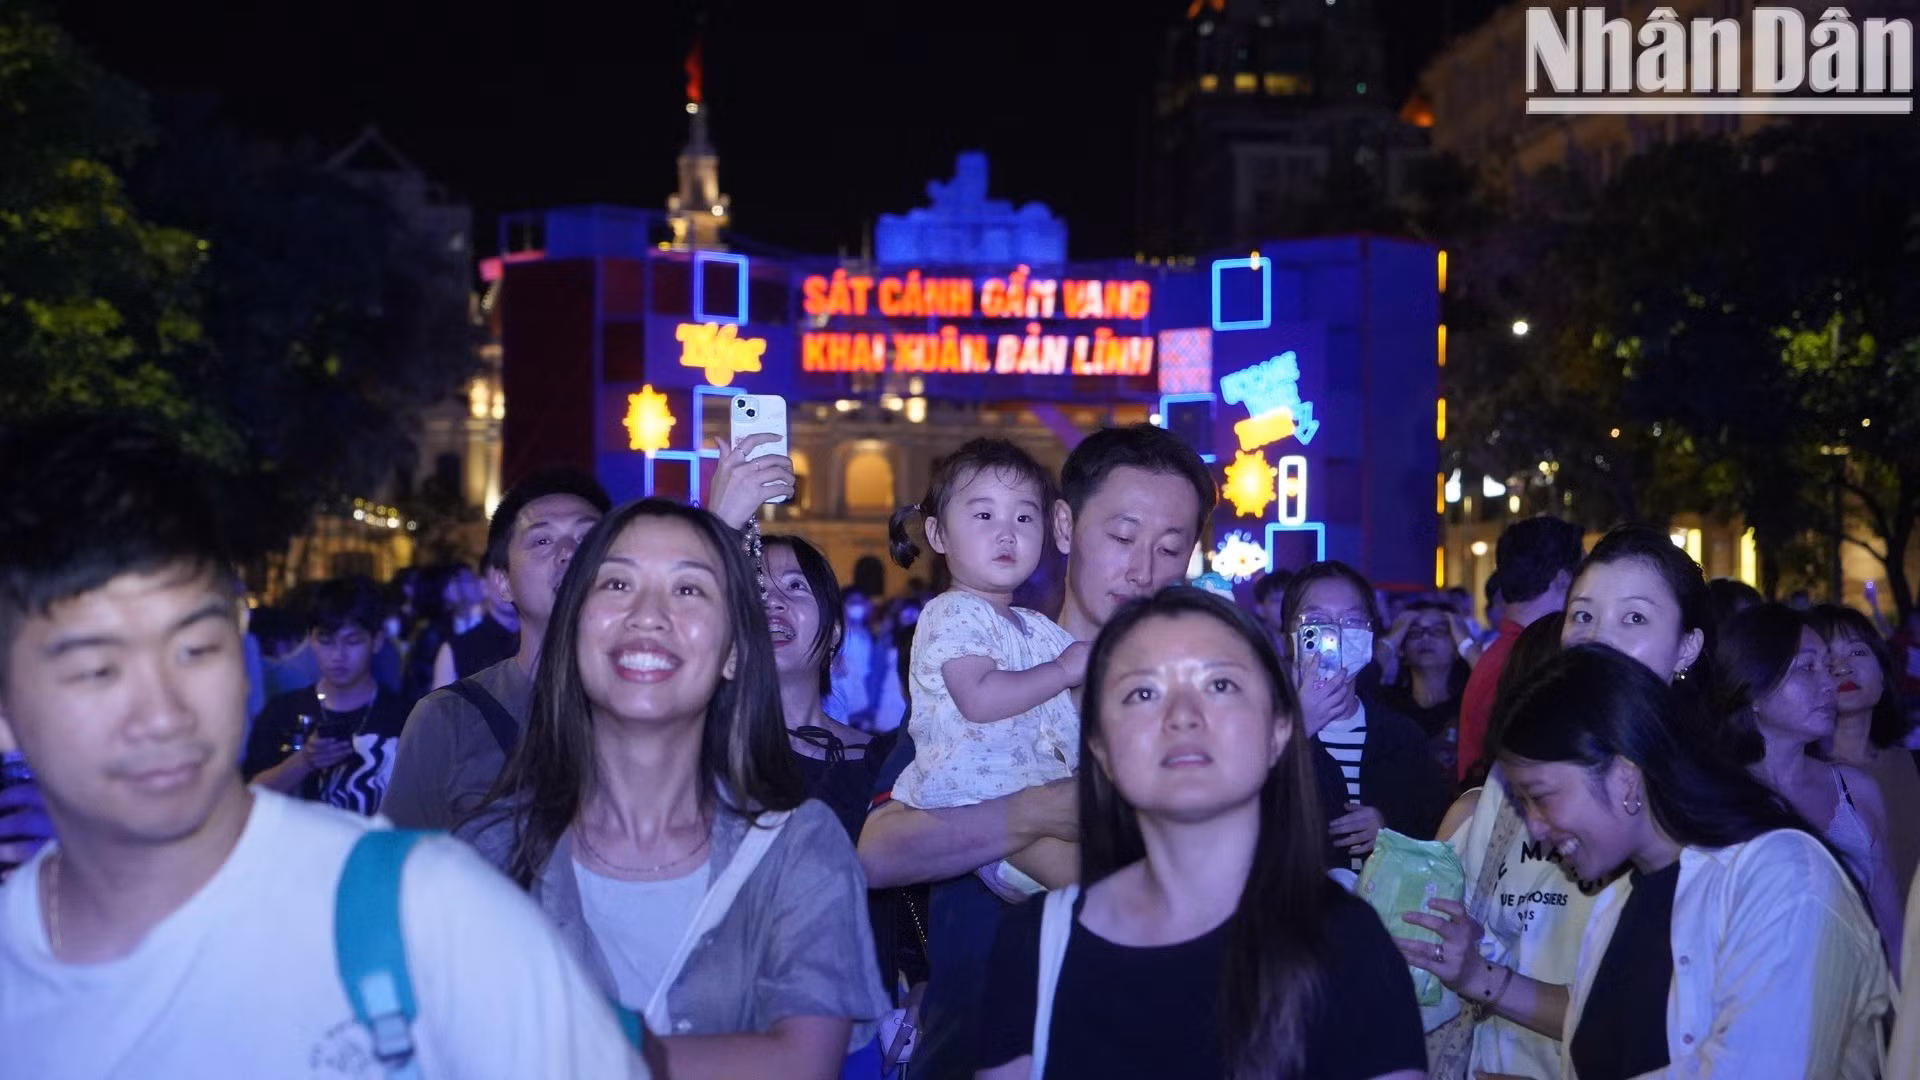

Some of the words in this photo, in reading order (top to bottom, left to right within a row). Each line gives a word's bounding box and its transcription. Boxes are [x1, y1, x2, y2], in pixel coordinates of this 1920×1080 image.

[803, 268, 873, 316] SÁT
[878, 269, 973, 317] CÁNH
[1063, 279, 1151, 320] VANG
[803, 333, 885, 373] KHAI
[995, 322, 1068, 375] BẢN
[1071, 327, 1154, 376] LĨNH
